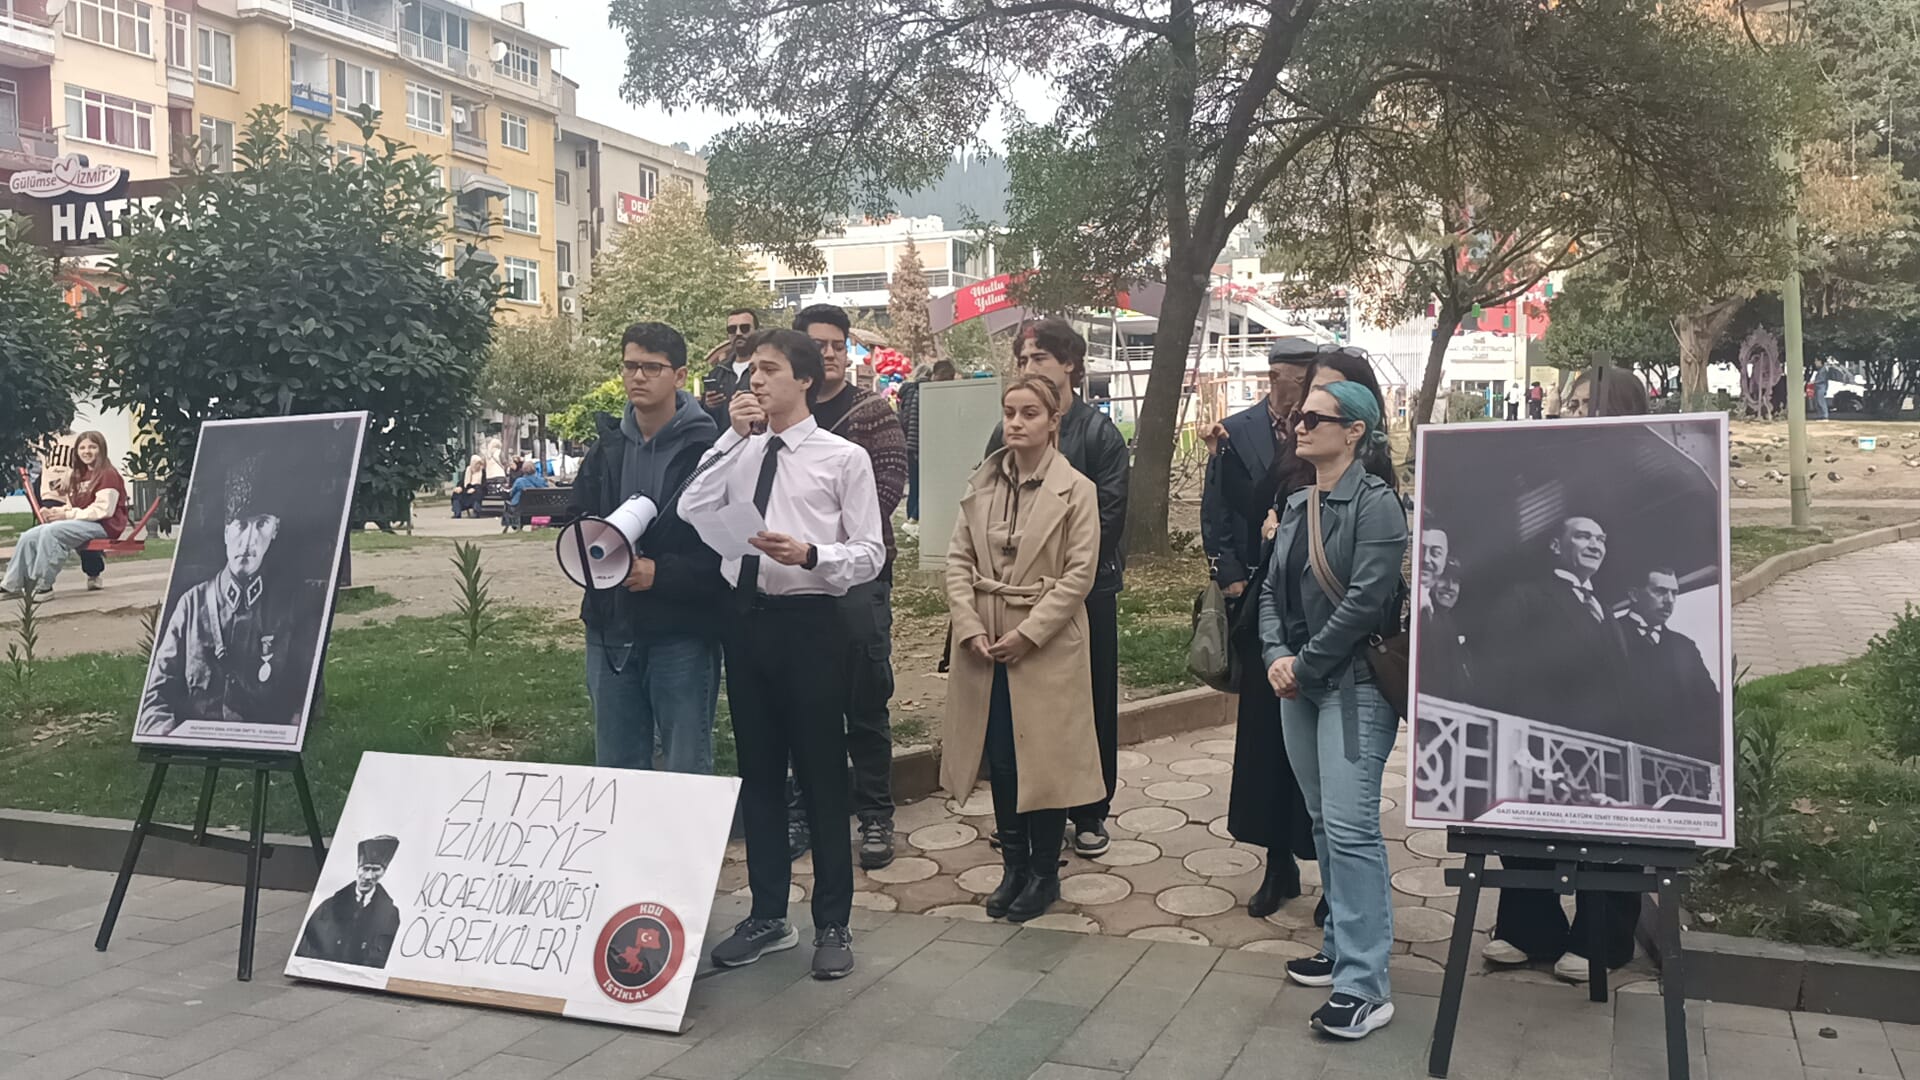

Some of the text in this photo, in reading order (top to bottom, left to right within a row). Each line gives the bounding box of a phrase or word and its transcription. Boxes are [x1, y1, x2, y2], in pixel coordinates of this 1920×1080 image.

[12, 176, 57, 191] Gülümse
[447, 770, 617, 825] ATAM
[435, 817, 607, 874] İZİNDEYİZ
[400, 908, 582, 975] ÖĞRENCİLERİ
